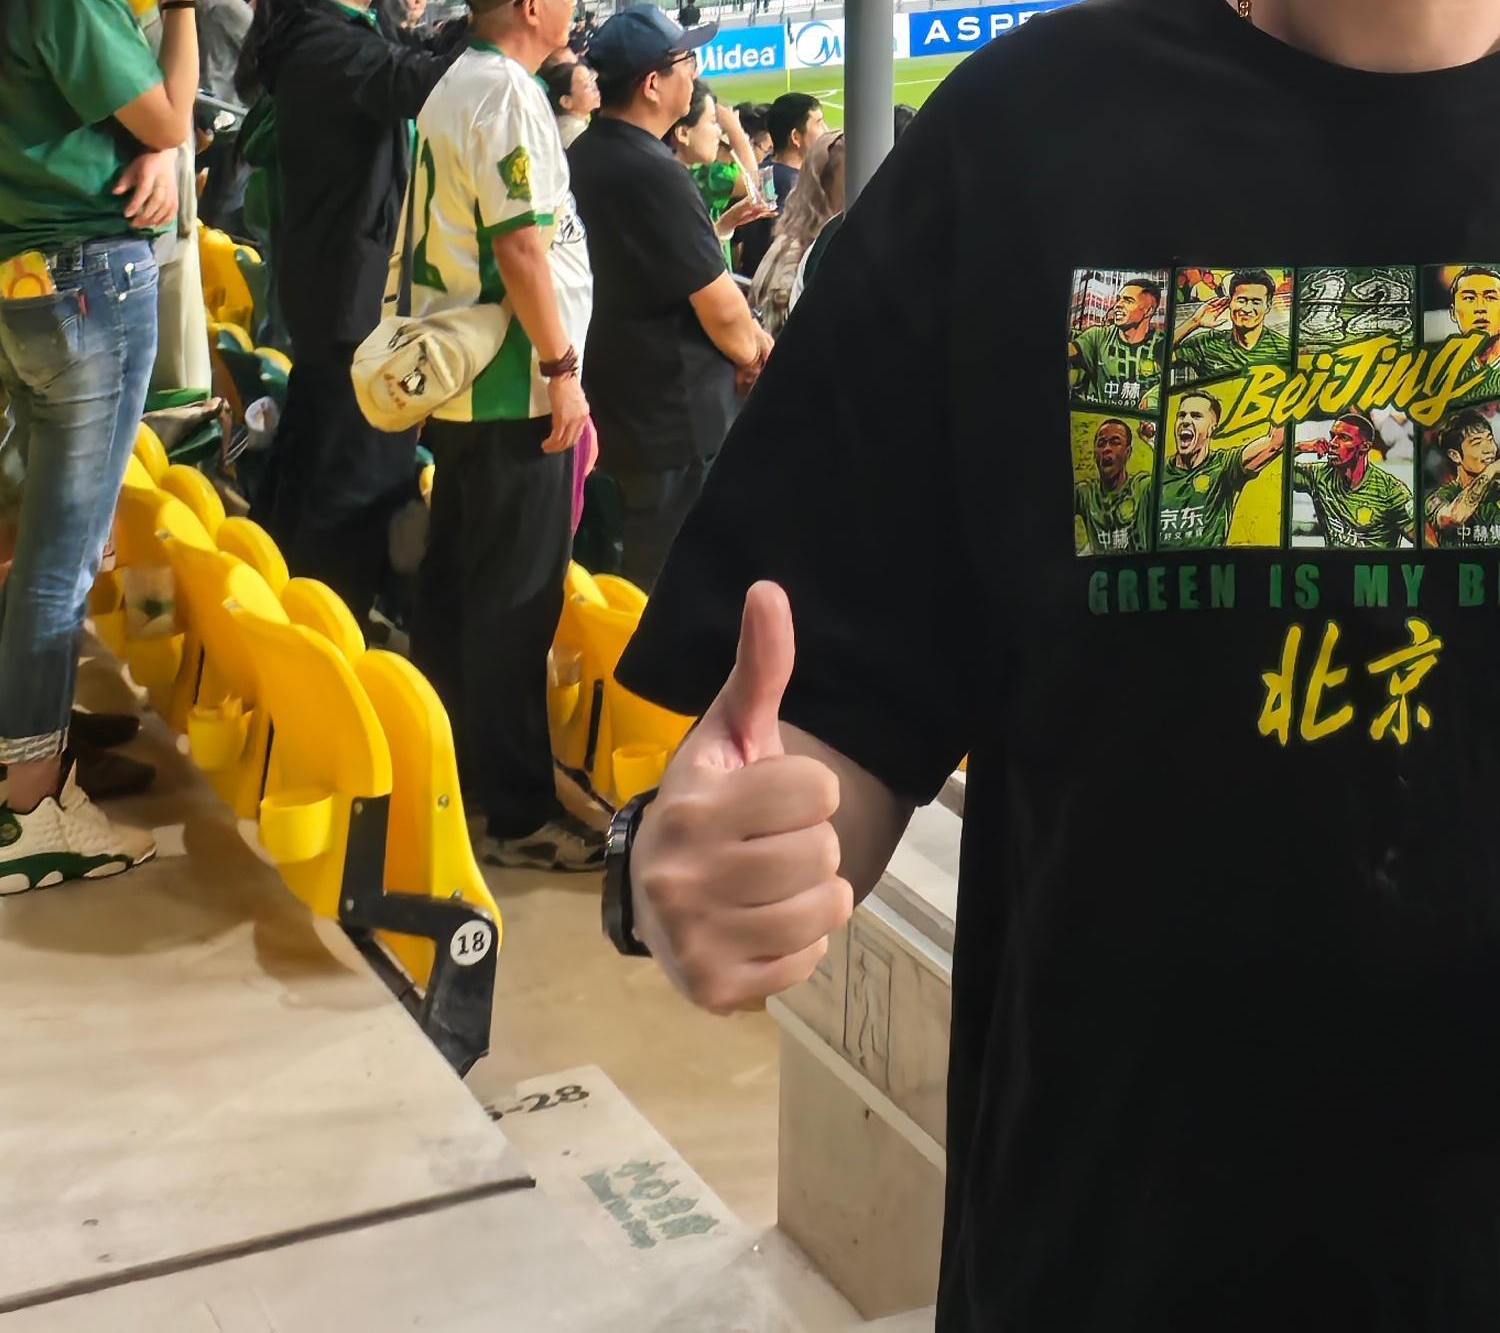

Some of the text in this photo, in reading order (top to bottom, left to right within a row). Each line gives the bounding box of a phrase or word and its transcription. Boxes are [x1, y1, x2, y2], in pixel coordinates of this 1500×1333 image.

[1160, 505, 1204, 530] 京东
[1088, 563, 1236, 614] GREEN
[1268, 563, 1321, 610] IS
[1353, 563, 1426, 608] MY
[1257, 616, 1443, 748] 北京
[457, 930, 485, 957] 18
